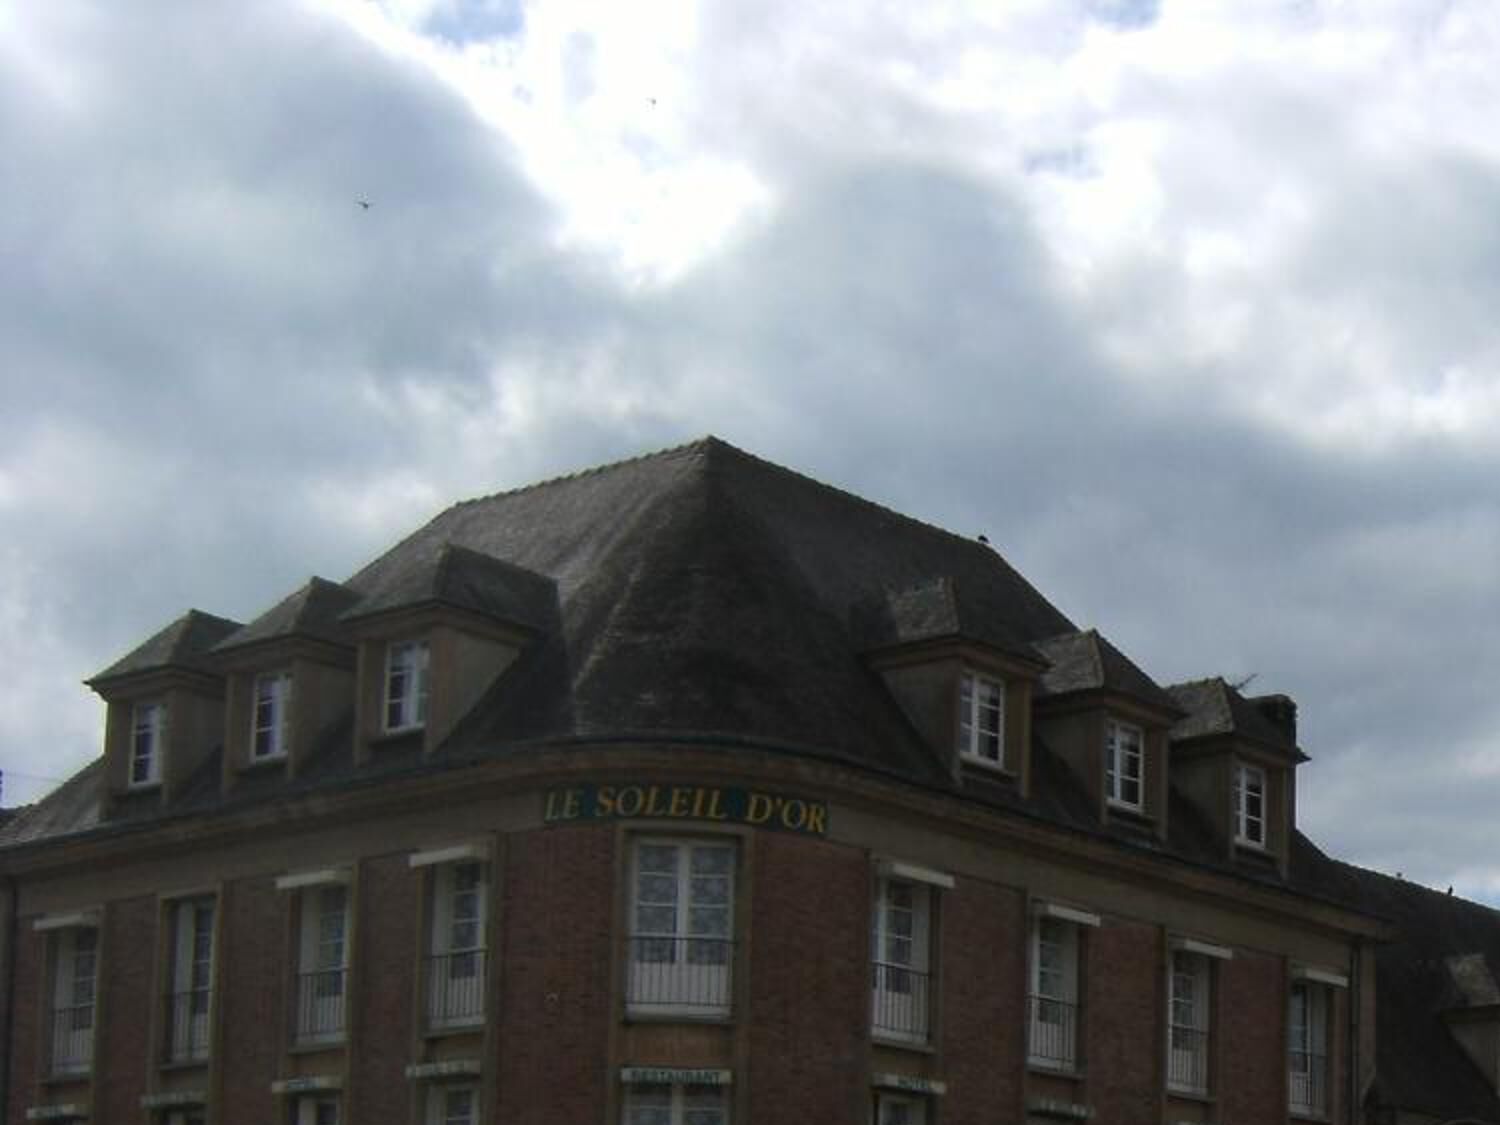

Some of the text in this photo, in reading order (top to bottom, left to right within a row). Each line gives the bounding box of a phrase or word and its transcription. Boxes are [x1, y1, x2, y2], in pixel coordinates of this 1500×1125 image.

[545, 786, 828, 833] LE SOLEIL D'OR
